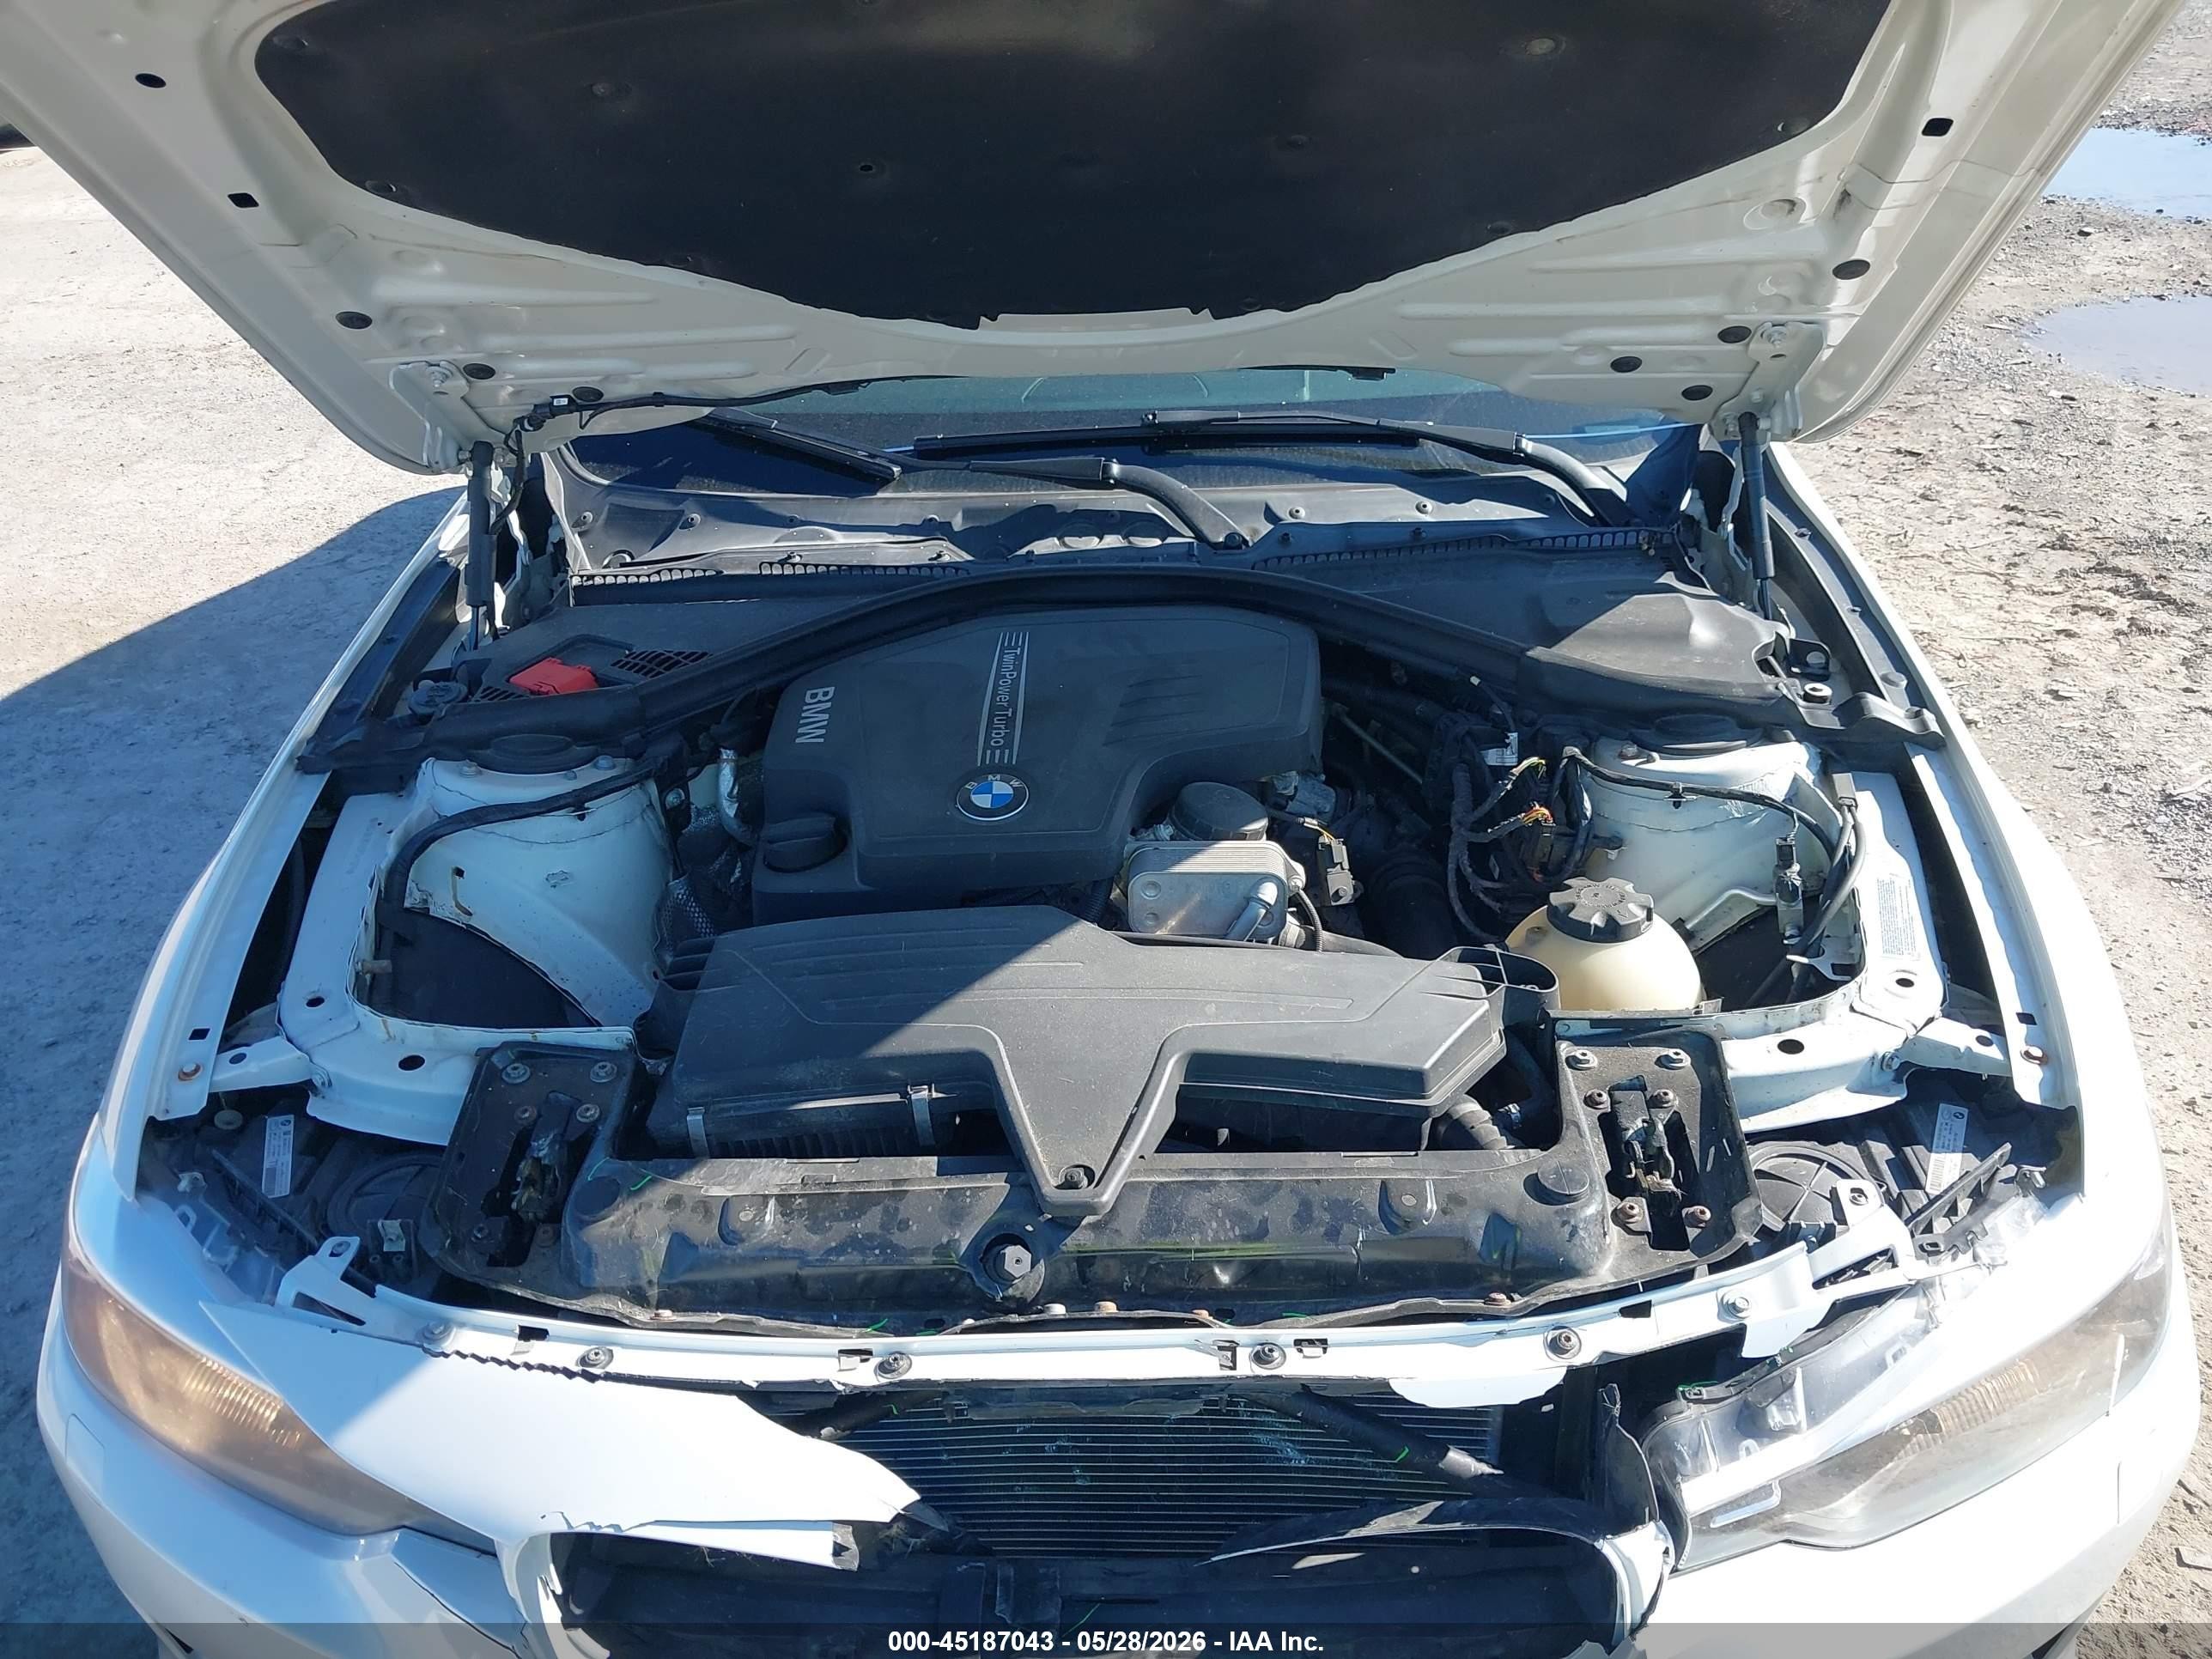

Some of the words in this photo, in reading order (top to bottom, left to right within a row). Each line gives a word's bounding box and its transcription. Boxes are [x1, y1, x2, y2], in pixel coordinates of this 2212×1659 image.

[995, 647, 1021, 707] TwinPower
[795, 687, 836, 743] BMW
[990, 708, 1013, 746] Turbo
[964, 775, 1024, 789] BMW
